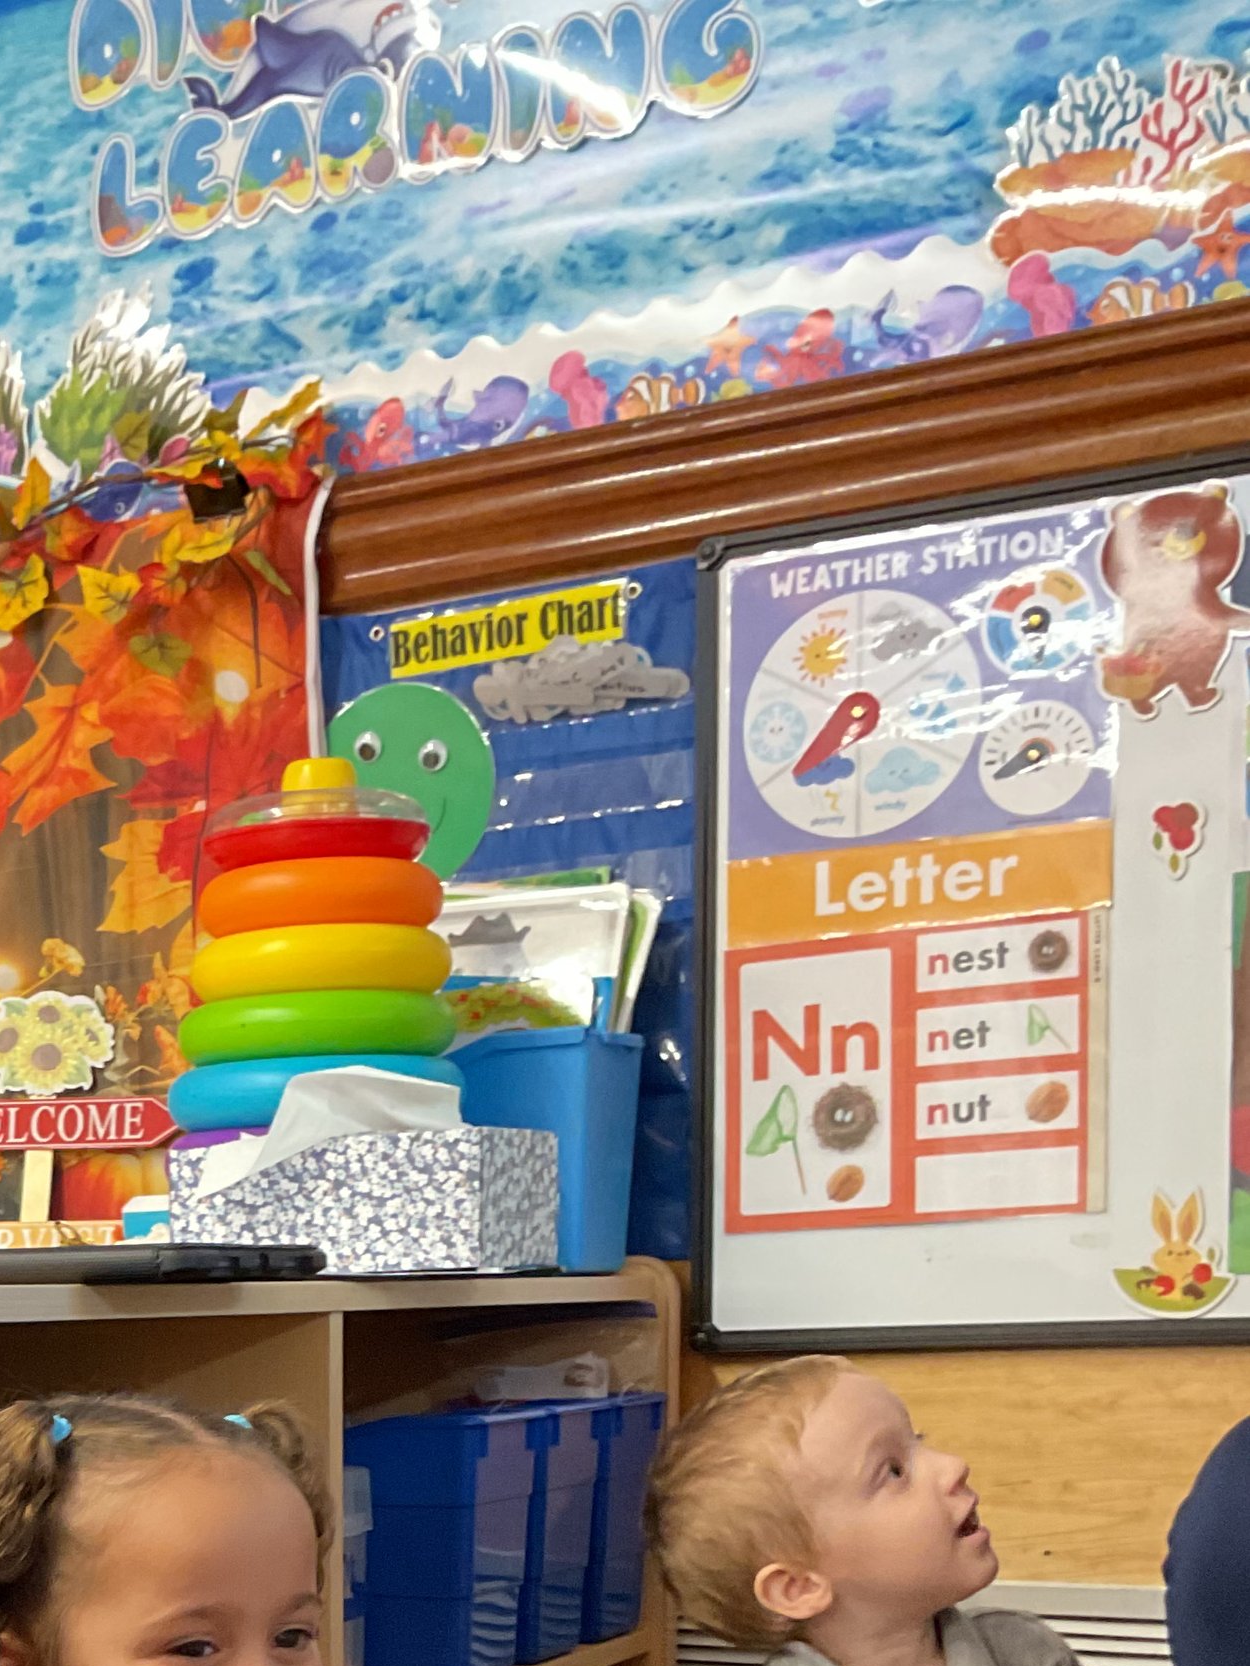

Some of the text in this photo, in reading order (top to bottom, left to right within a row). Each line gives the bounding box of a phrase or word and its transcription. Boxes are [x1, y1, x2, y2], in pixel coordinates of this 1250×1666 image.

[91, 0, 763, 257] LEARNING
[769, 526, 1065, 599] WEATHER STATION
[391, 589, 623, 669] Behavior Chart
[814, 853, 1019, 916] Letter
[927, 941, 1009, 975] nest
[752, 1003, 881, 1081] Nn
[927, 1020, 991, 1052] net
[927, 1093, 991, 1127] nut
